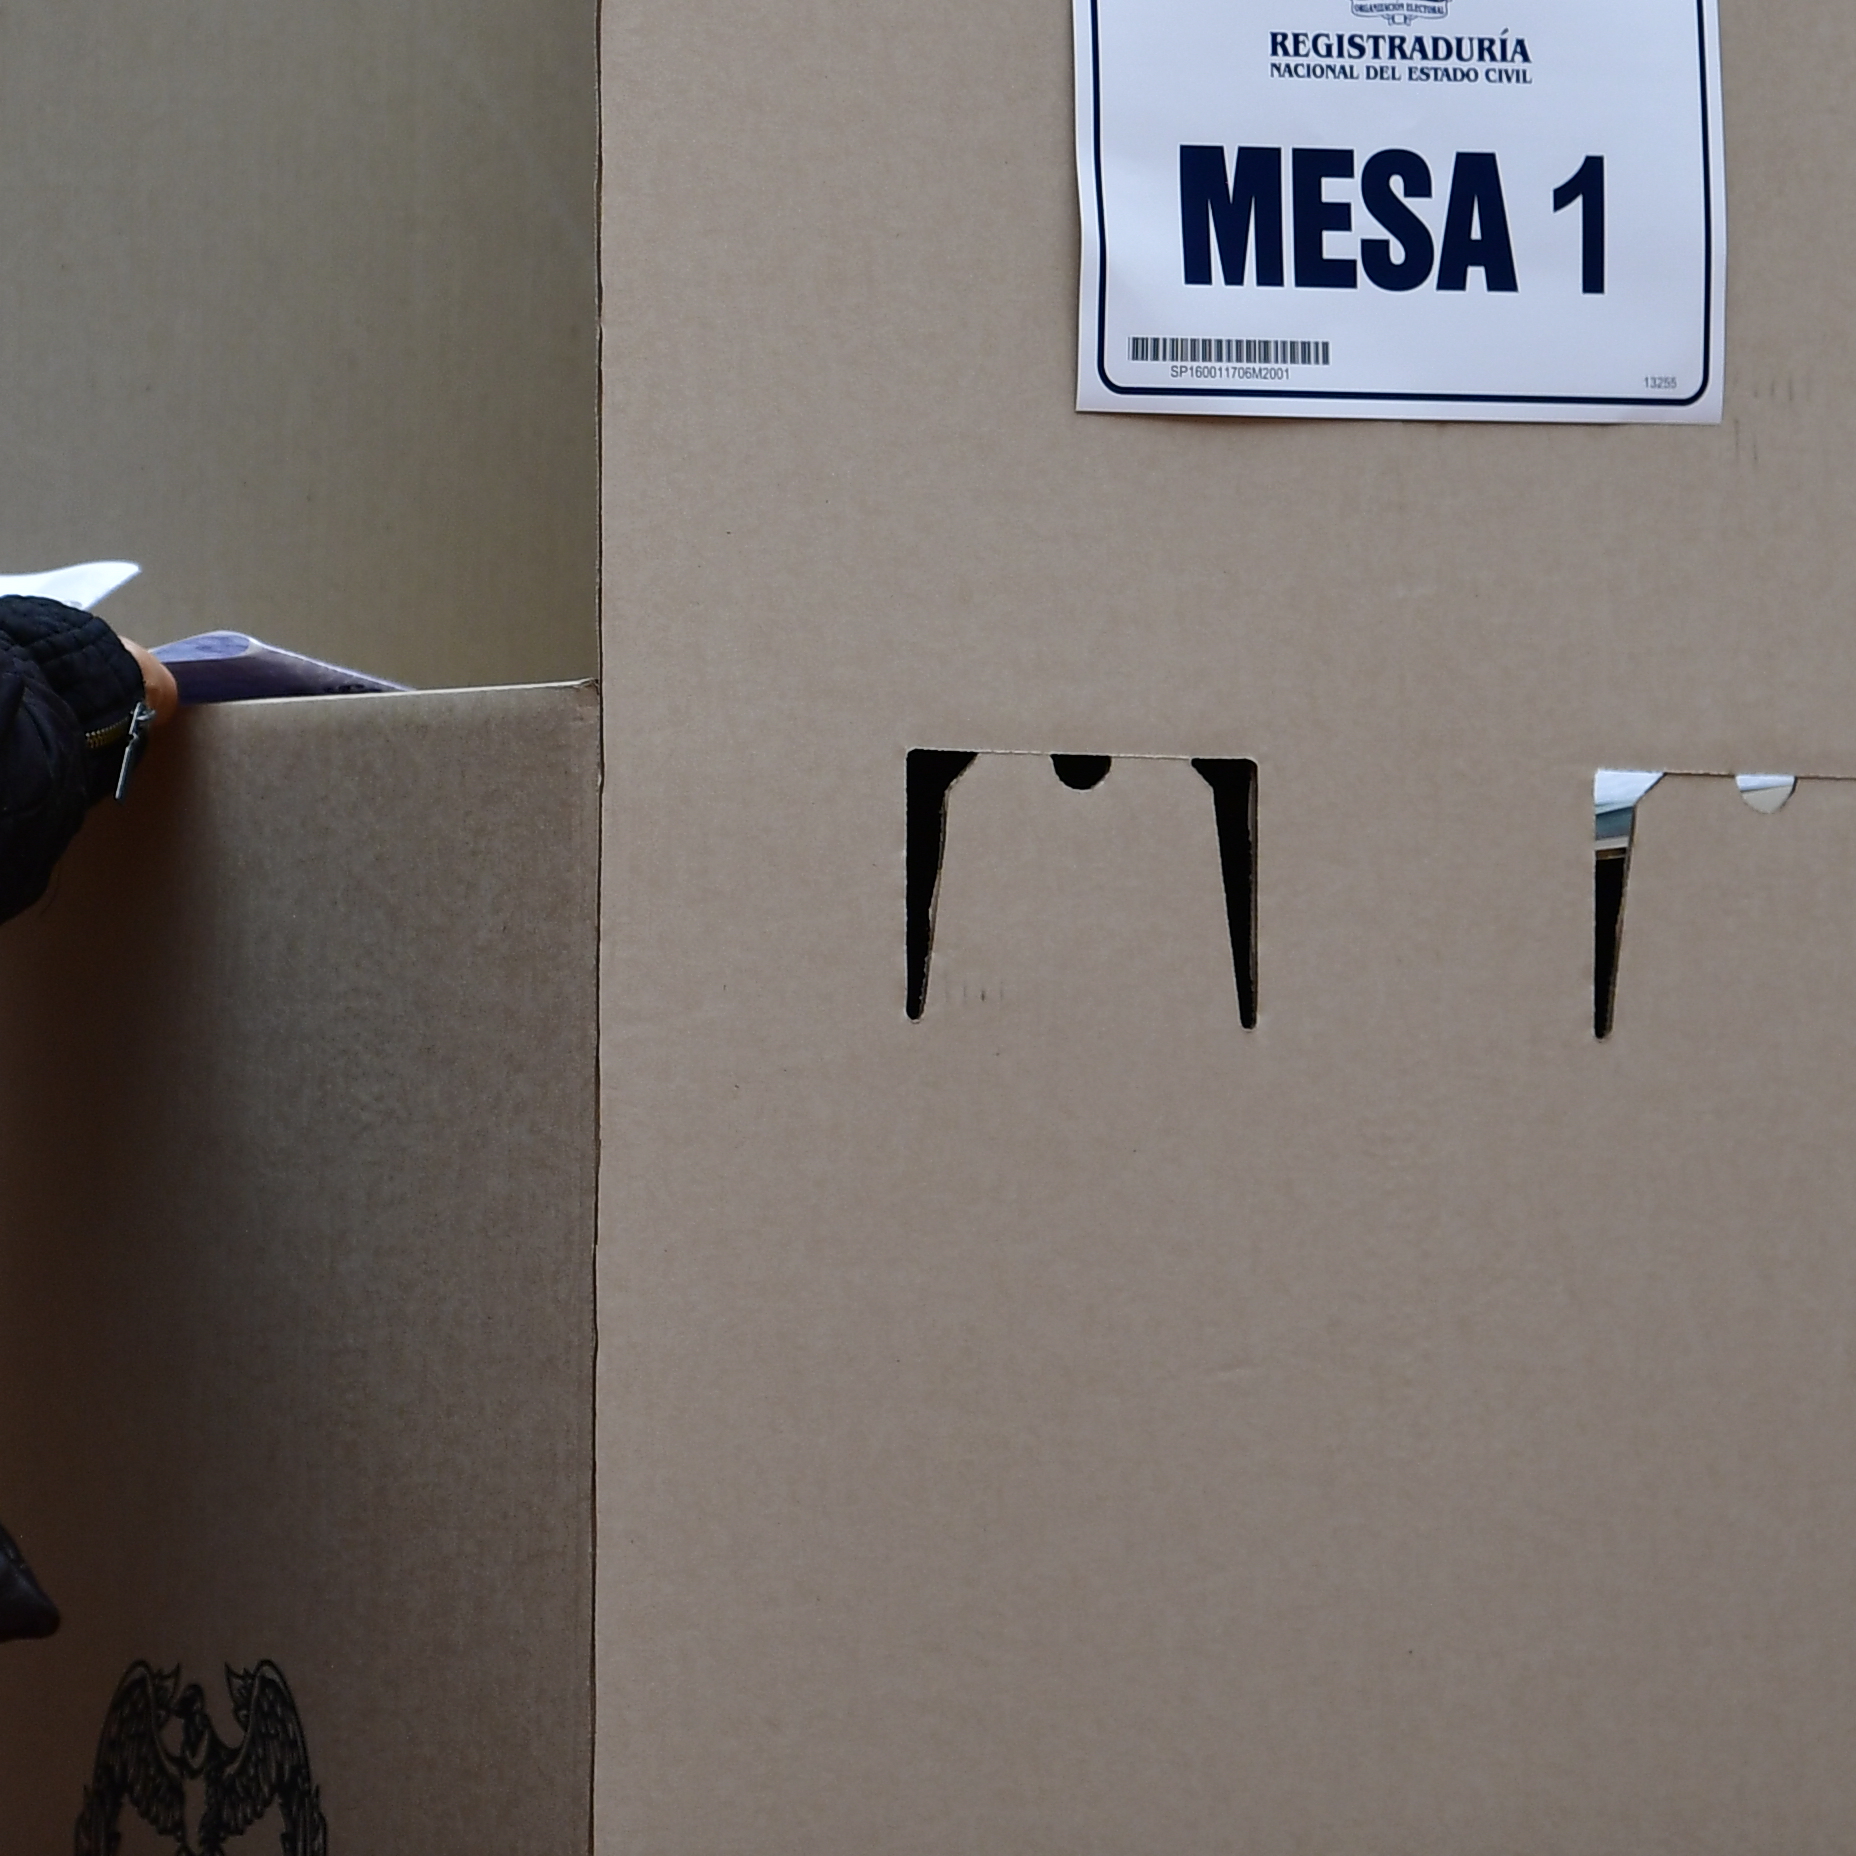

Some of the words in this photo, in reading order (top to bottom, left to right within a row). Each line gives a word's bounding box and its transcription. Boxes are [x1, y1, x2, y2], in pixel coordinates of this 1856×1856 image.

[1269, 28, 1532, 63] REGISTRADURÍA
[1270, 62, 1359, 80] NACIONAL
[1365, 65, 1401, 81] DEL
[1408, 66, 1479, 83] ESTADO
[1485, 68, 1533, 84] CIVIL
[1179, 144, 1519, 293] MESA
[1552, 155, 1606, 294] 1
